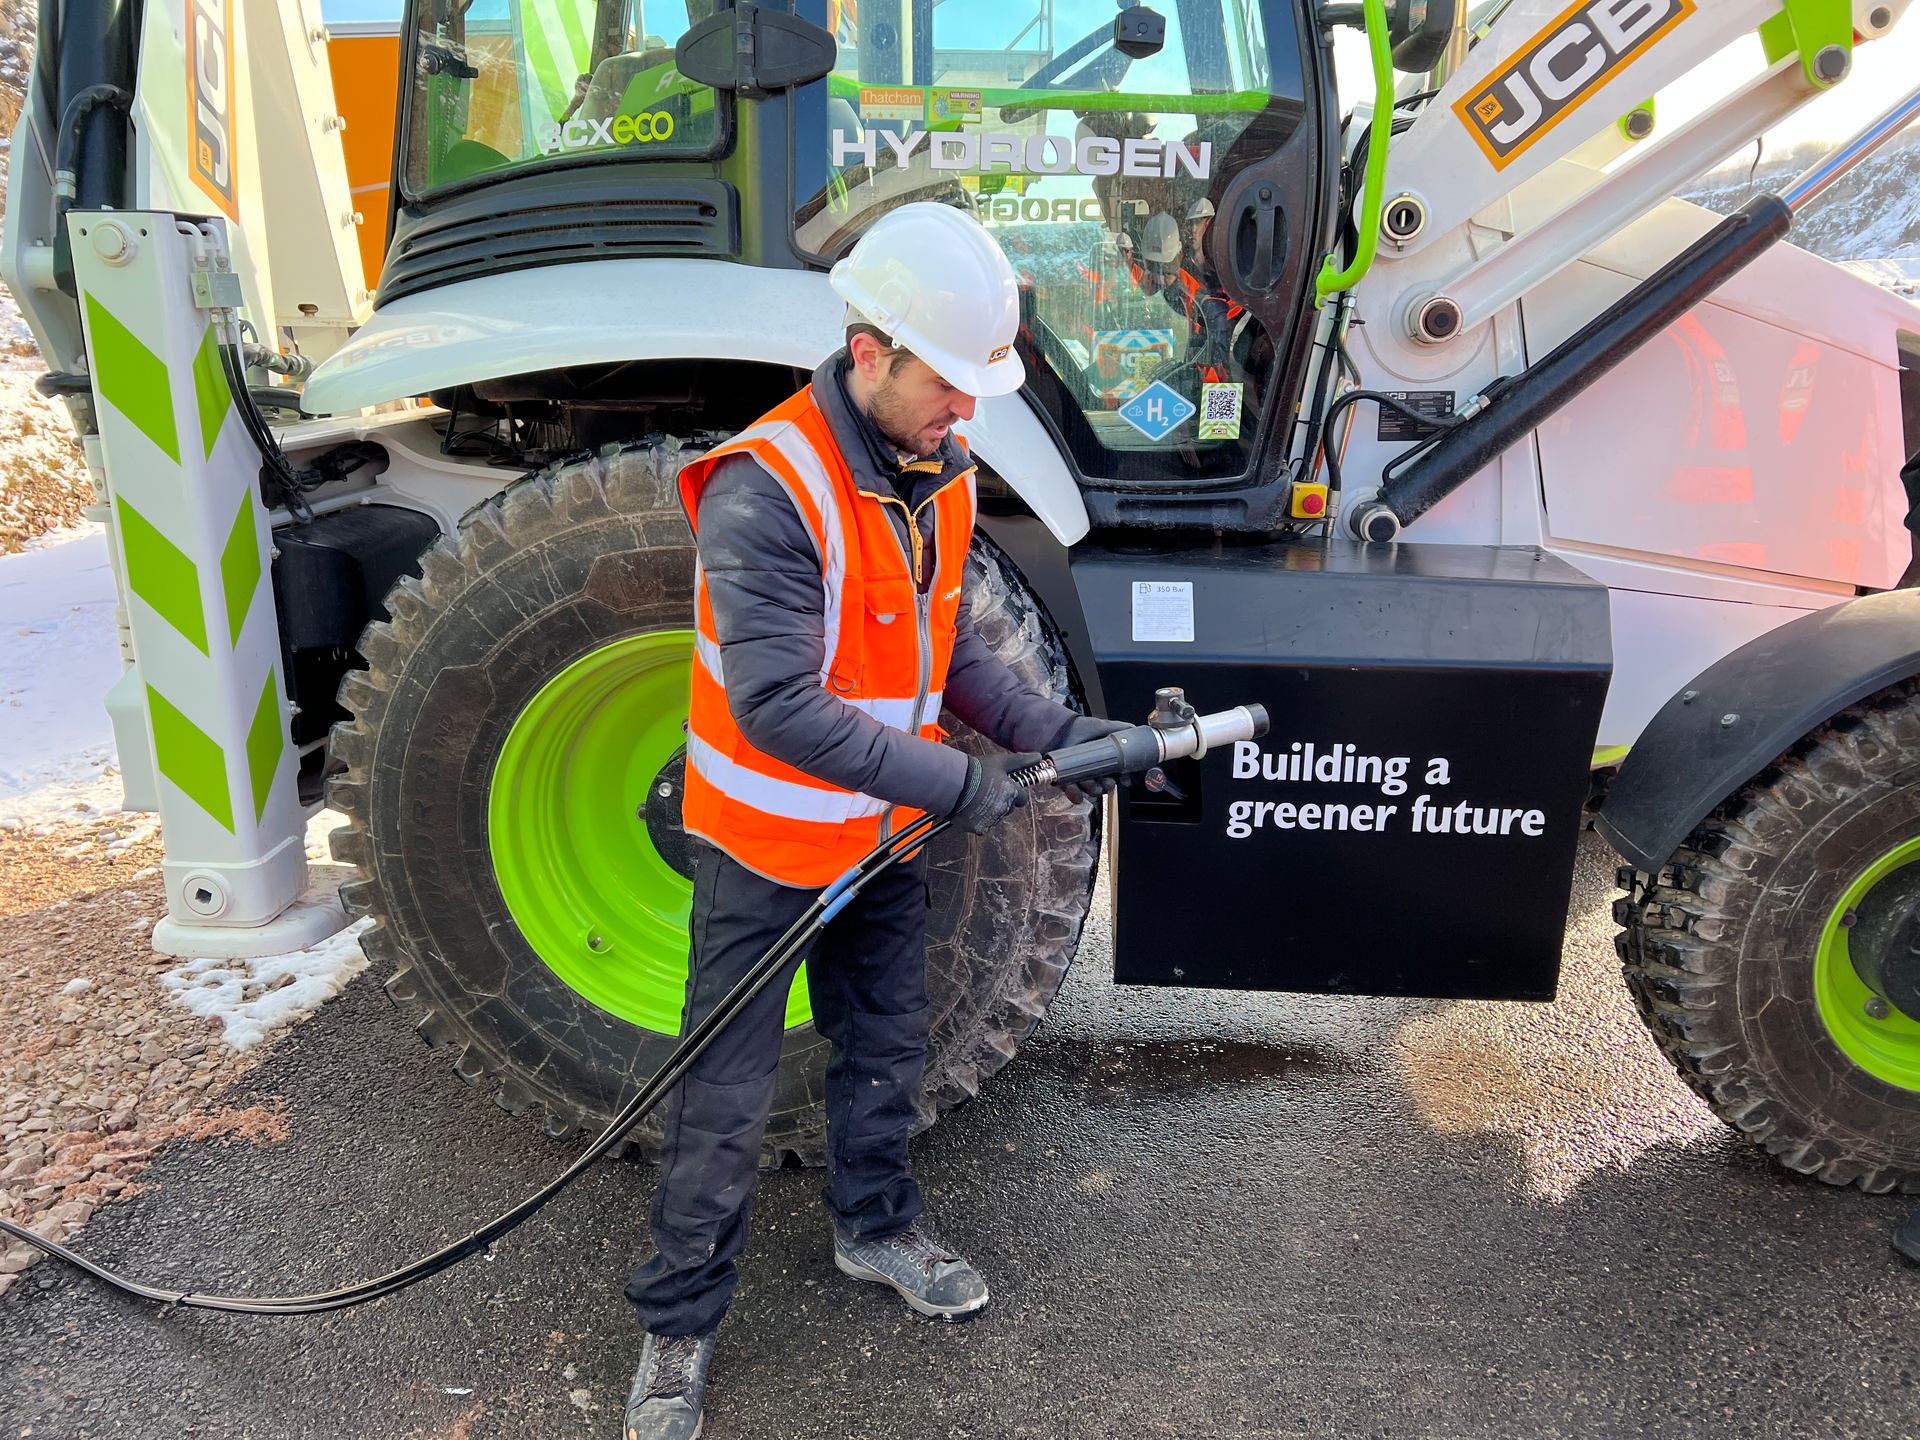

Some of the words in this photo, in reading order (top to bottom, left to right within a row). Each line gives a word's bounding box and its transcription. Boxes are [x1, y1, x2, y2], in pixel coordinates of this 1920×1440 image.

[861, 90, 921, 104] Thatcham
[539, 111, 674, 150] 3CXeco
[832, 129, 1212, 179] HYDROGEN
[990, 348, 1008, 361] JCB
[1232, 740, 1410, 796] Building
[1424, 757, 1451, 785] a
[1226, 800, 1398, 839] greener
[1411, 794, 1546, 837] future
